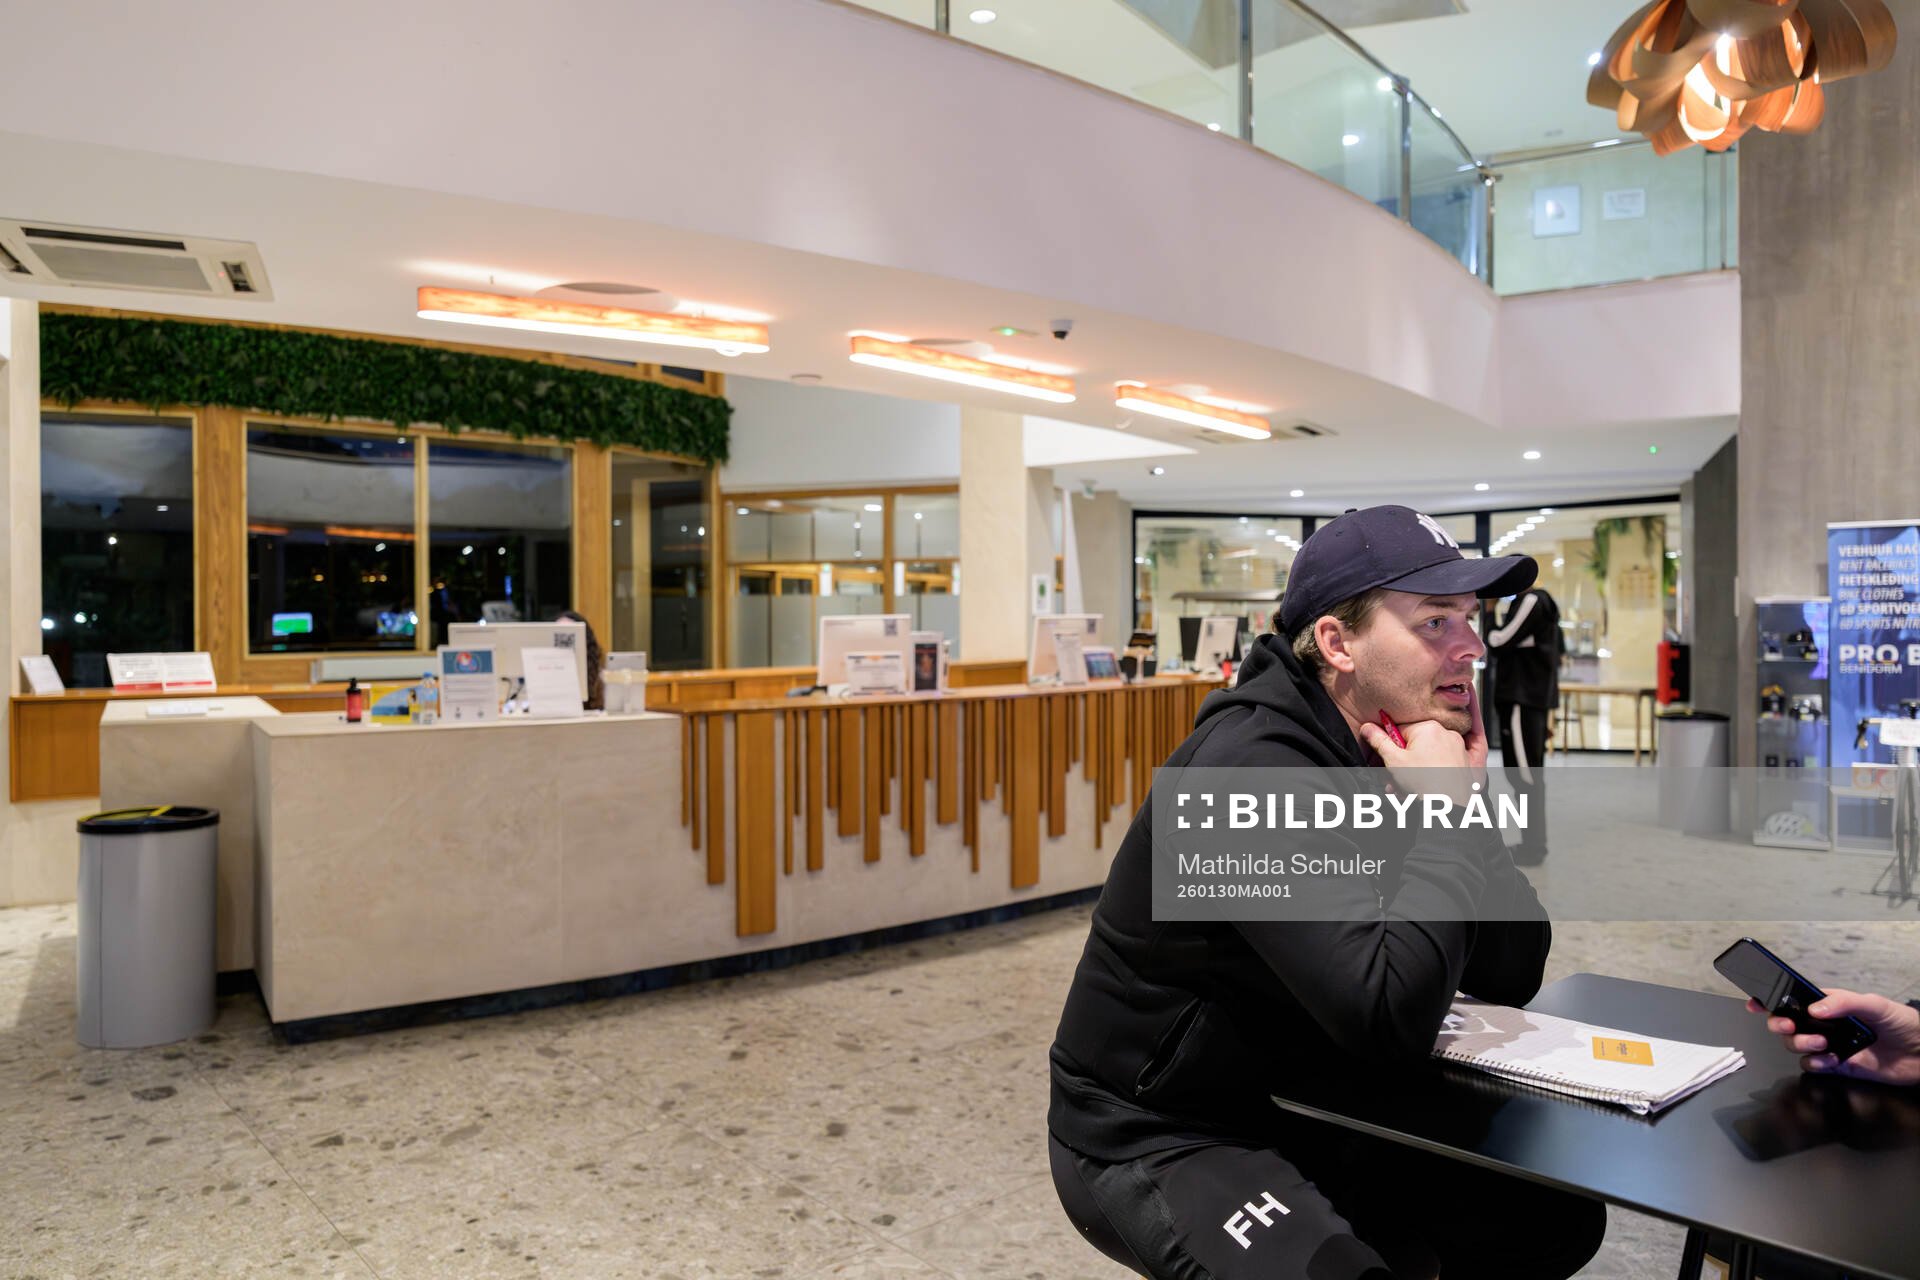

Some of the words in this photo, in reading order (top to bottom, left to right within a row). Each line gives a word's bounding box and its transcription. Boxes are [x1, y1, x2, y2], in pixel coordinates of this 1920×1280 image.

[1838, 544, 1892, 557] VERHUUR
[1839, 560, 1863, 571] RENT
[1839, 573, 1919, 586] FIETSKLEDING
[1862, 587, 1904, 600] CLOTHES
[1857, 602, 1920, 615] SPORTVOE
[1855, 618, 1890, 630] SPORTS
[1839, 644, 1899, 664] PRO
[1839, 664, 1903, 675] BENIDORM
[1223, 1191, 1291, 1250] FH
